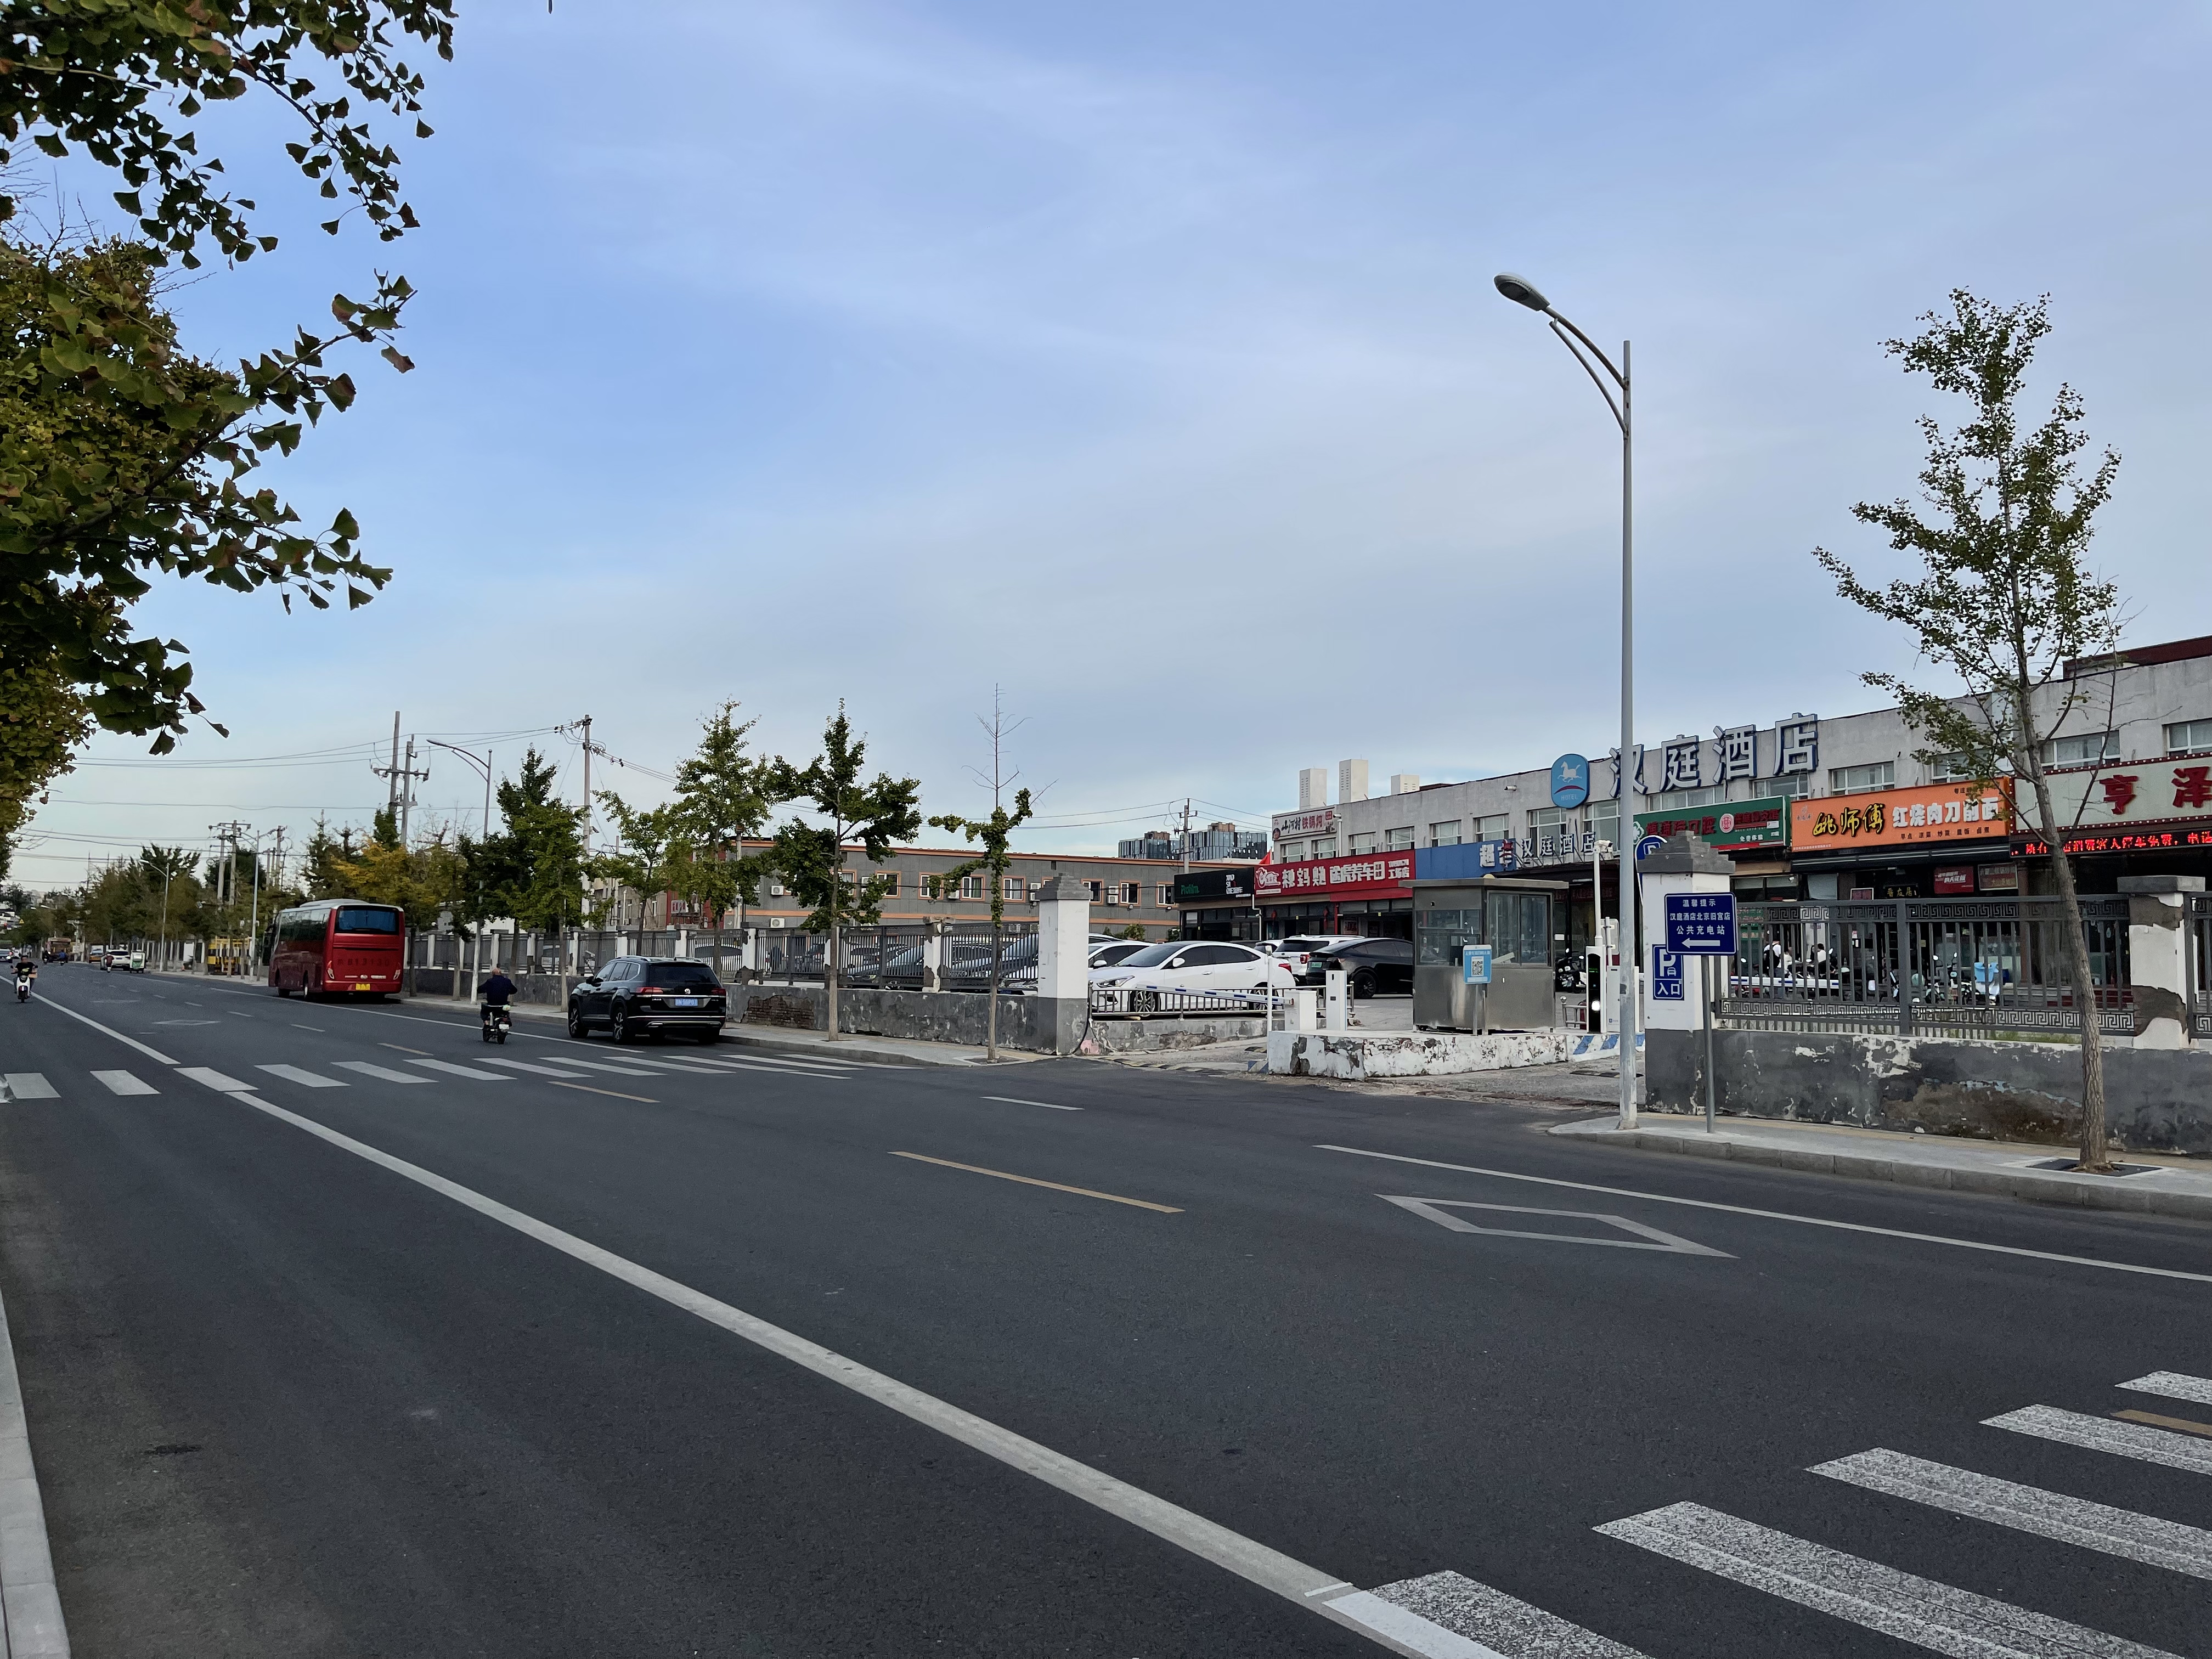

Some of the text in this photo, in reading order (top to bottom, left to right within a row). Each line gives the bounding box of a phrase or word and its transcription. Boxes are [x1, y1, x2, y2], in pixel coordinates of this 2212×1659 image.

[1609, 712, 1819, 798] 汉庭酒店
[1813, 803, 1885, 837] 姚师傅
[1520, 831, 1596, 859] 汉庭酒店
[1682, 899, 1716, 907] 温馨提示
[1669, 912, 1730, 921] 汉庭酒店北京旧宫店
[1676, 925, 1725, 935] 公共充电站
[1659, 949, 1676, 977] P
[1657, 982, 1680, 996] 入口
